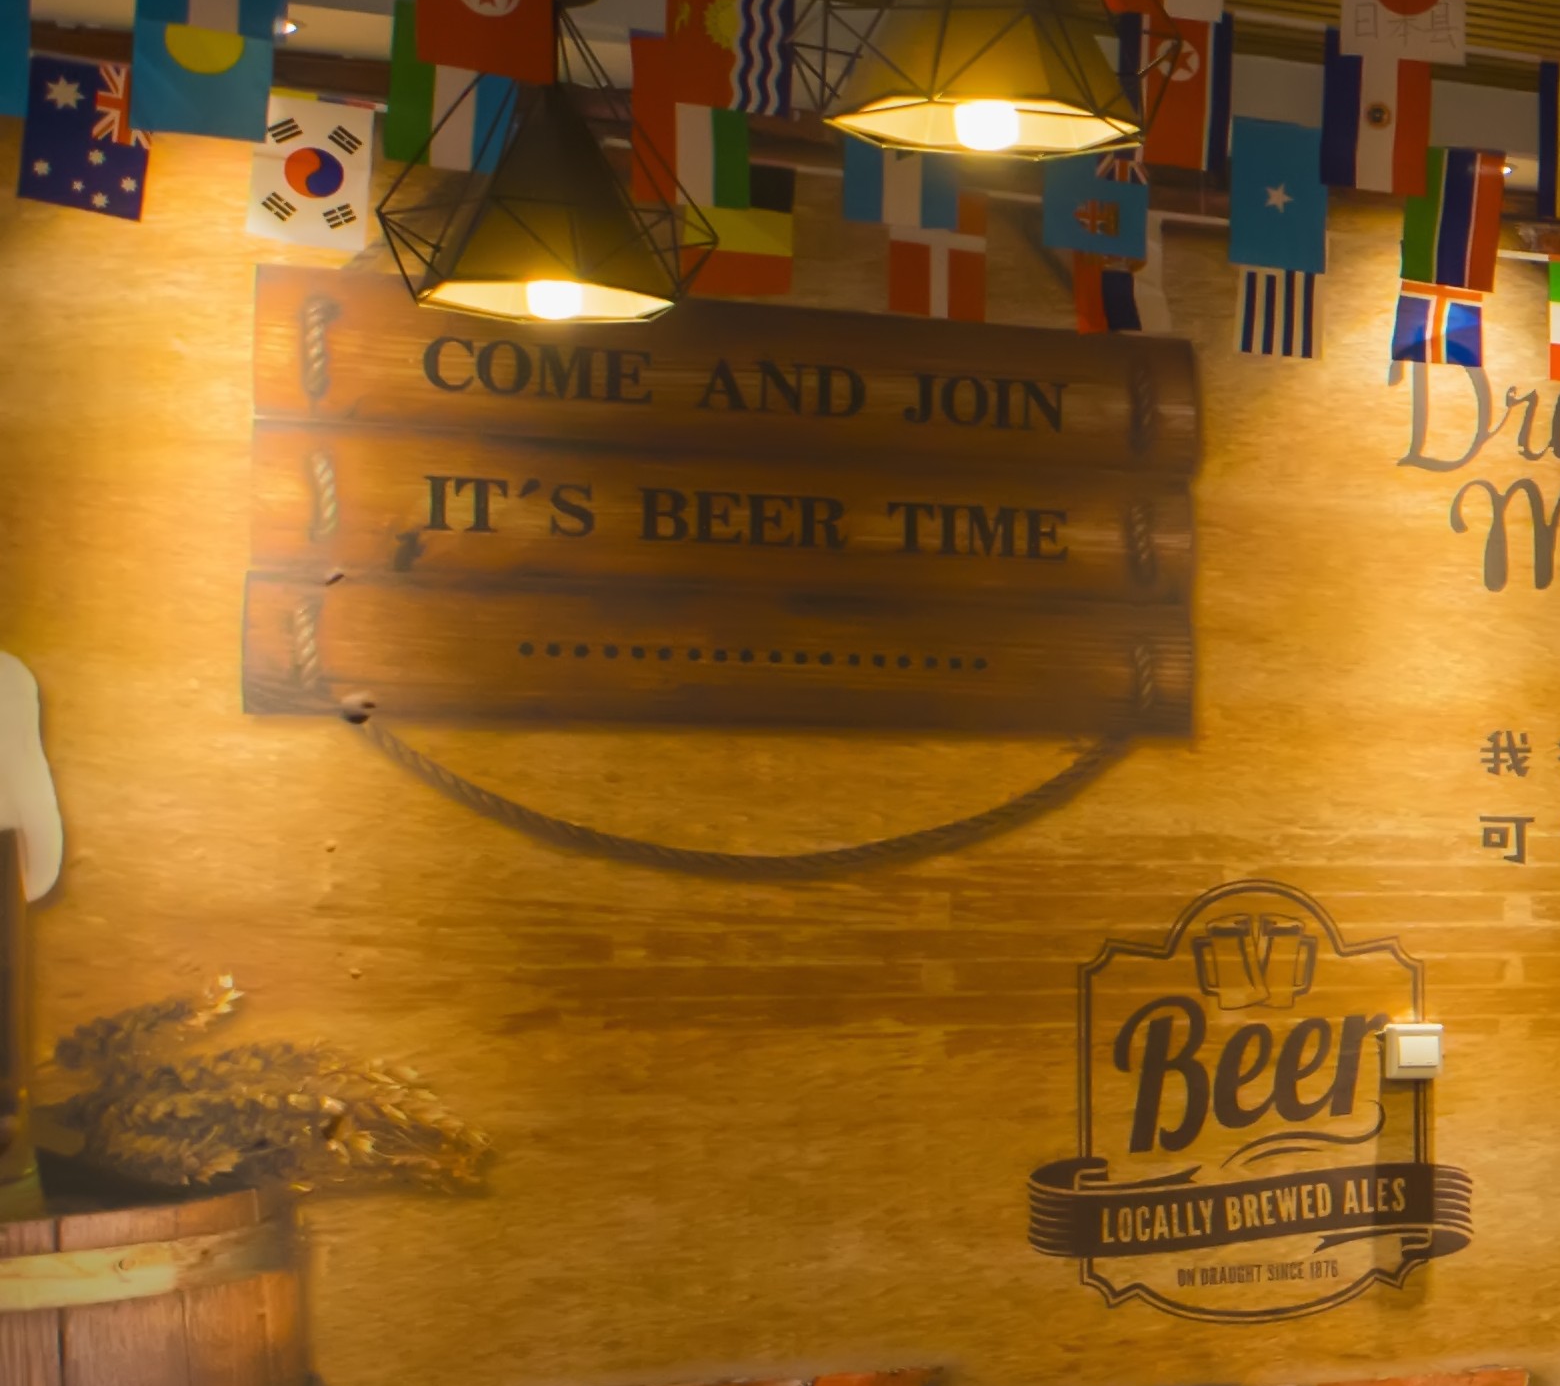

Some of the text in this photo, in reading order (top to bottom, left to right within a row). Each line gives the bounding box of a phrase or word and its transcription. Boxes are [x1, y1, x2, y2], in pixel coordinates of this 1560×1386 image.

[423, 335, 1068, 433] COME AND JOIN
[640, 488, 848, 552] BEER
[888, 500, 1070, 562] TIME
[1113, 995, 1392, 1154] Beer
[1102, 1177, 1407, 1244] LOCALLY BREWED ALES
[1267, 1260, 1305, 1281] SINCE
